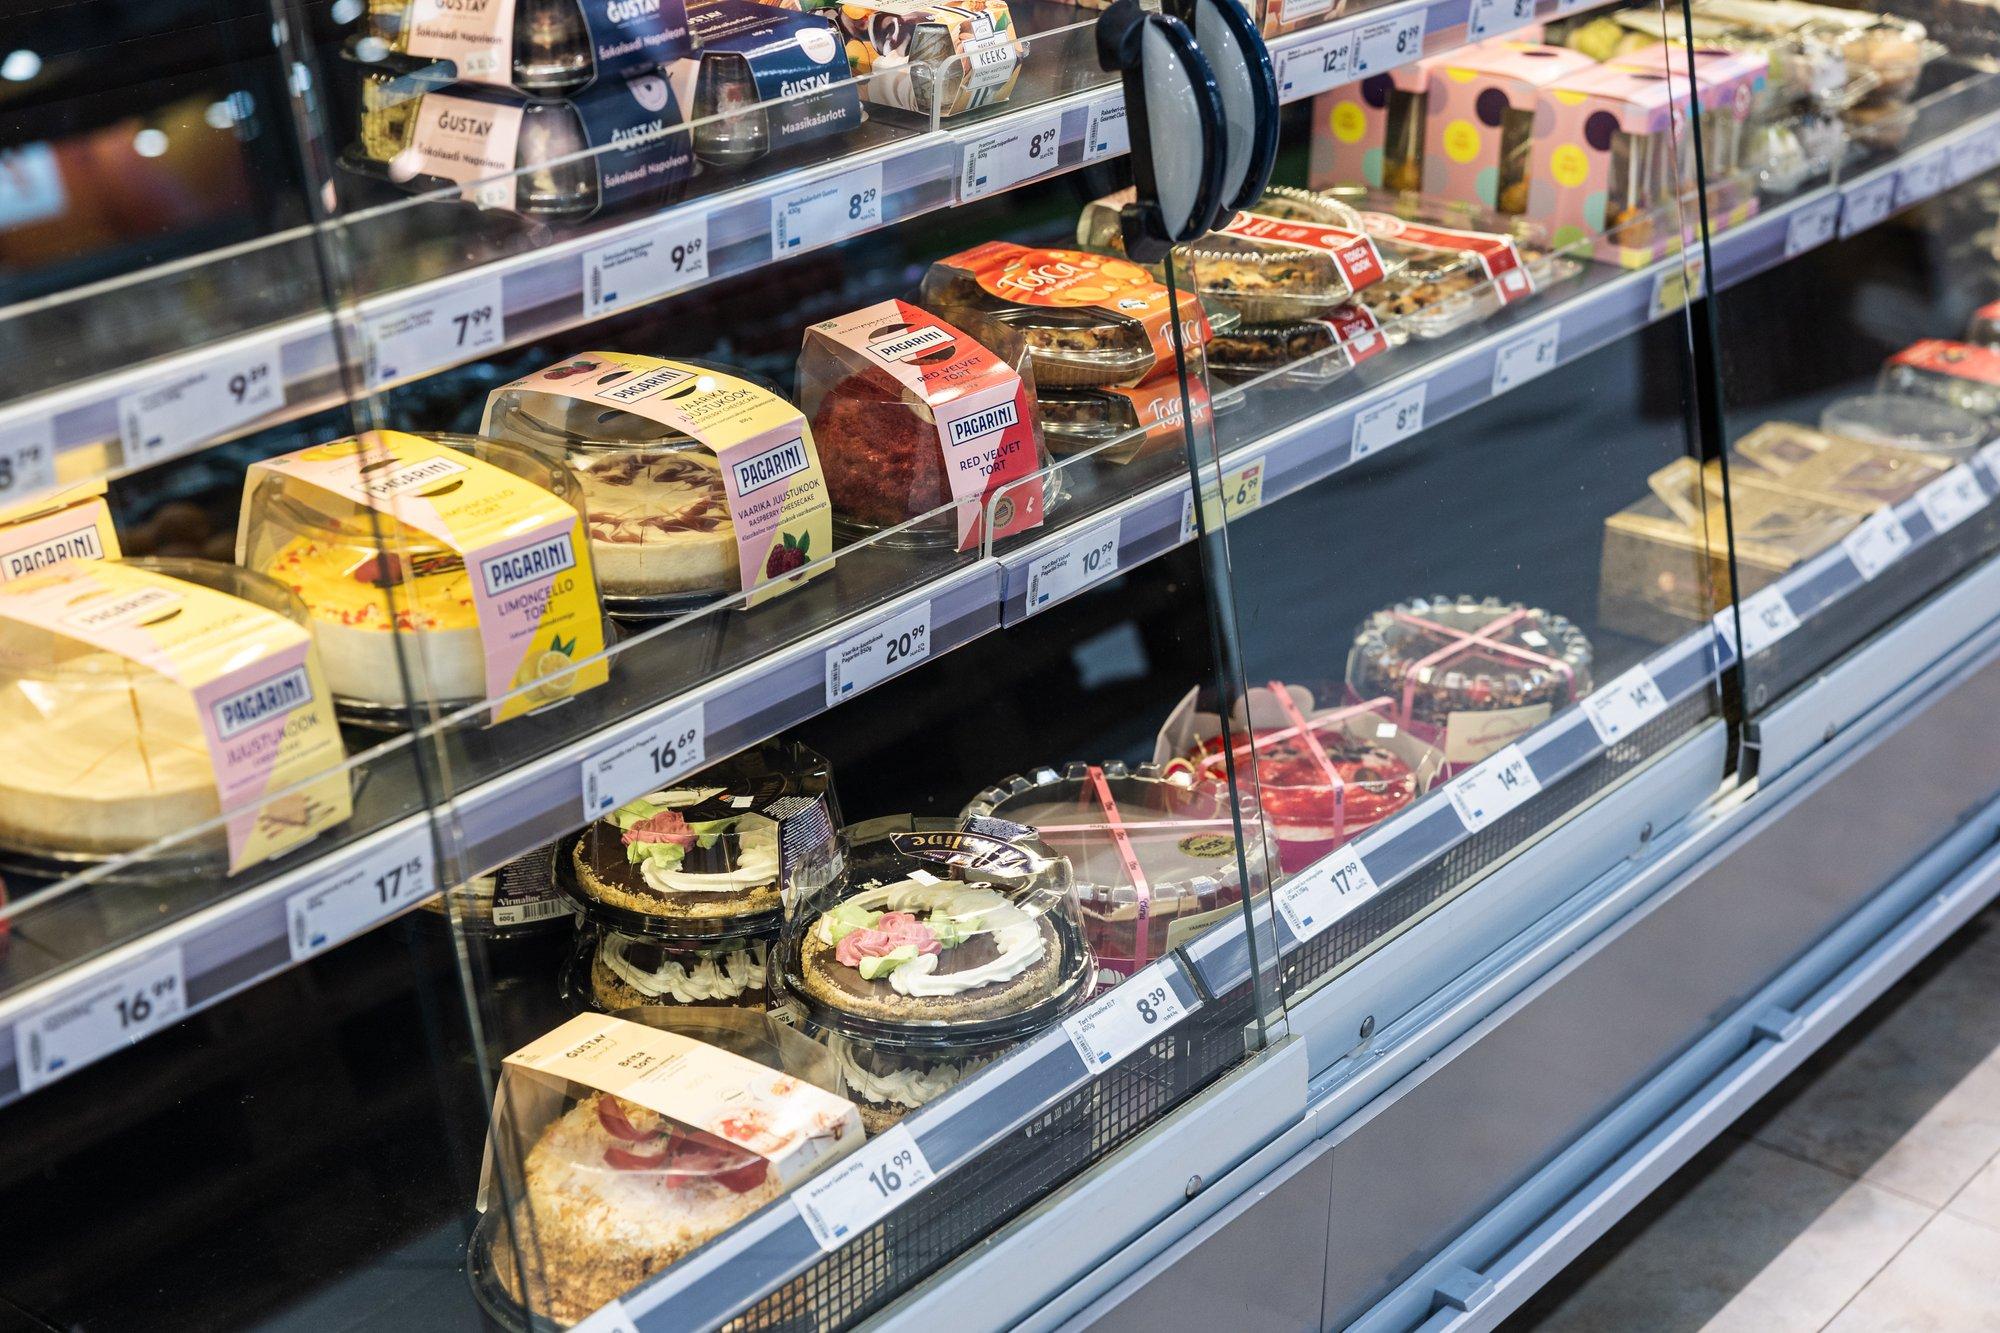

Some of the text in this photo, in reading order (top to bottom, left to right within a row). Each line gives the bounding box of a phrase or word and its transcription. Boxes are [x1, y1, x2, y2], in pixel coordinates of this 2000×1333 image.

[979, 47, 1008, 66] KEEKS
[781, 107, 847, 137] Maasikašarlott
[880, 330, 943, 357] PAGARINI
[612, 369, 681, 401] PAGARINI
[916, 370, 940, 384] RED
[941, 355, 982, 373] VELVET
[942, 369, 972, 383] TORT
[676, 387, 728, 413] VAARIKA
[678, 387, 753, 423] JUUSTUKOOK
[955, 406, 1013, 440] PAGARINI
[740, 445, 803, 488] PAGARINI
[960, 440, 1022, 471] RED VELVET
[979, 459, 1007, 477] TORT
[737, 478, 821, 520] VAARIKA JUUSTUKOOK
[749, 493, 816, 527] RASPBERRY CHEESECAKE
[11, 533, 94, 577] PAGARINI
[491, 541, 568, 587] PAGARINI
[497, 578, 575, 617] LIMONCELLO
[524, 600, 554, 621] TORT
[221, 674, 306, 730] PAGARINI
[910, 834, 1029, 867] Valine
[566, 1032, 606, 1059] GUSTAV
[618, 1050, 646, 1070] Brita
[633, 1056, 656, 1071] tort
